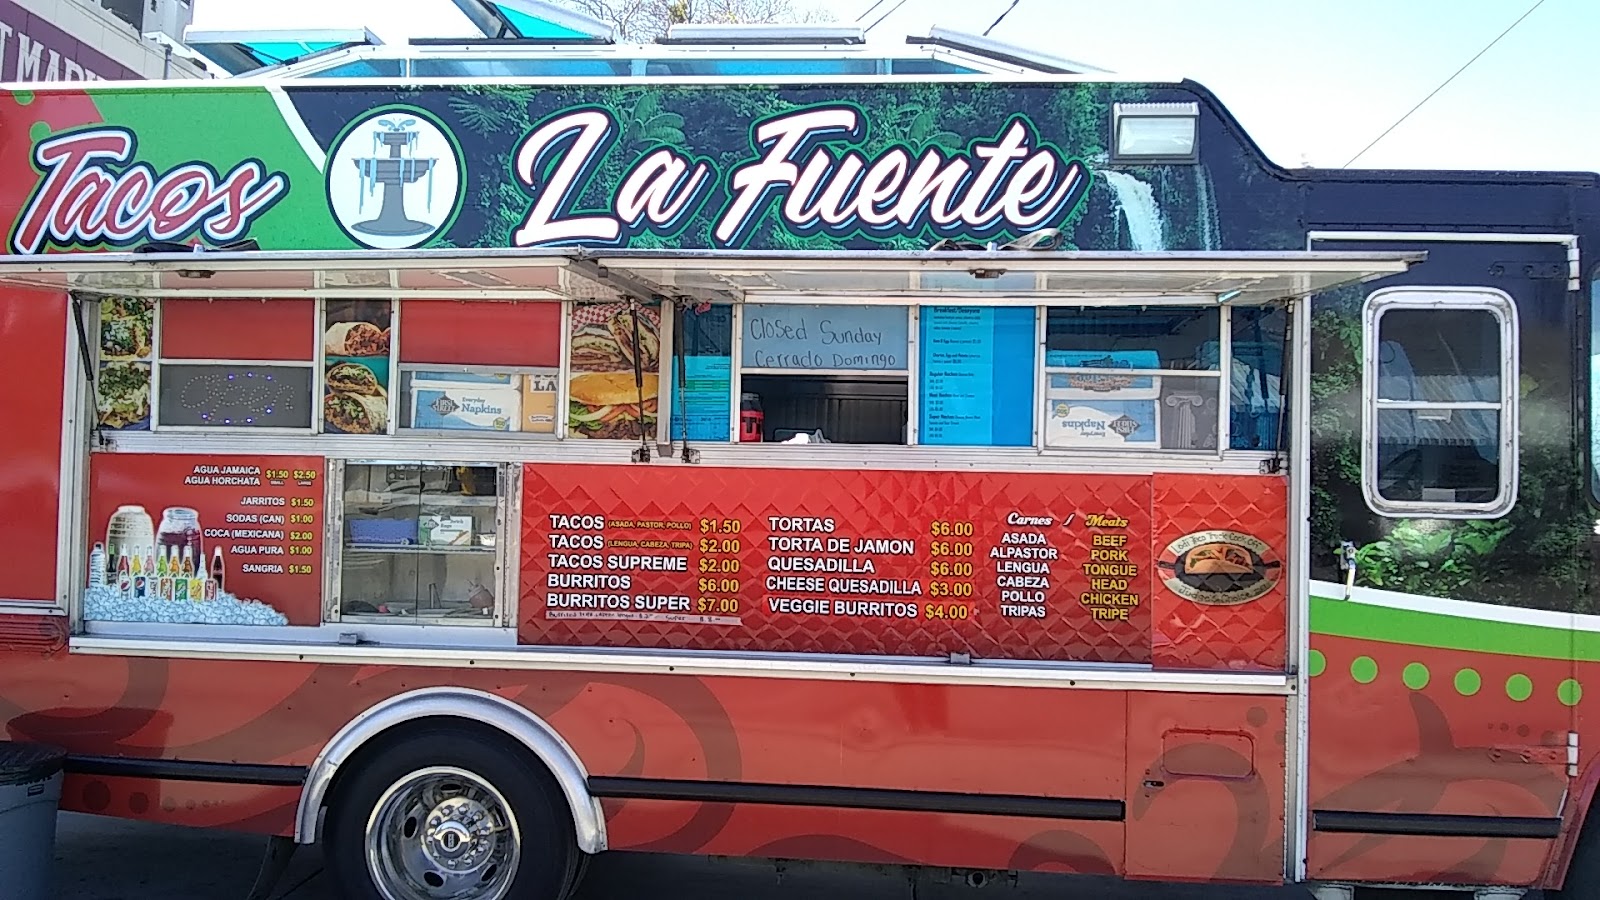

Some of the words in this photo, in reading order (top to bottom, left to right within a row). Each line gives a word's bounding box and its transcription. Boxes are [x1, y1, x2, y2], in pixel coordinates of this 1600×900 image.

[515, 110, 709, 247] La
[714, 110, 1081, 243] Fuente
[14, 130, 284, 253] Tacos
[819, 319, 882, 346] Sunday
[755, 349, 823, 368] Cerrado
[832, 353, 896, 370] Domingo
[180, 373, 295, 424] Open
[462, 396, 486, 404] Everyday
[461, 403, 502, 416] Napkins
[1062, 419, 1106, 430] Napkins
[193, 466, 221, 474] AGUA
[221, 466, 260, 475] JAMAICA
[266, 469, 289, 480] $1.50
[293, 470, 316, 480] $2.50
[184, 476, 212, 485] AGUA
[212, 476, 260, 486] HORCHATA
[240, 497, 286, 506] JARRITOS
[290, 497, 314, 507] $1.50
[226, 514, 258, 523] SODAS
[259, 514, 286, 525] (CAN)
[290, 514, 313, 524] $1.00
[549, 514, 605, 530] TACOS
[608, 520, 636, 529] (ASADA,
[666, 521, 692, 530] POLLO)
[700, 518, 740, 534] $1.50
[768, 516, 834, 532] TORTAS
[931, 521, 974, 536] $6.00
[1007, 512, 1053, 526] Carnes
[1085, 514, 1128, 528] Meats
[204, 528, 230, 538] COCA
[231, 529, 284, 540] (MEXICANA)
[290, 530, 312, 540] $2.00
[1001, 532, 1047, 545] ASADA
[1093, 534, 1127, 546] BEEF
[230, 546, 257, 554] AGUA
[258, 546, 284, 555] PURA
[289, 545, 312, 555] $1.00
[548, 534, 604, 550] TACOS
[671, 541, 694, 550] TRIPA)
[699, 538, 740, 554] $2.00
[768, 536, 824, 552] TORTA
[827, 538, 850, 553] DE
[854, 539, 914, 554] JAMON
[931, 542, 973, 556] $6.00
[990, 547, 1058, 560] ALPASTOR
[1091, 549, 1128, 562] PORK
[242, 564, 284, 574] SANGRIA
[288, 564, 312, 574] $1.50
[548, 554, 603, 569] TACOS
[607, 556, 688, 571] SUPREME
[698, 558, 740, 573] $2.00
[767, 556, 875, 574] QUESADILLA
[930, 562, 972, 576] $6.00
[996, 561, 1050, 574] LENGUA
[1083, 564, 1138, 576] TONGUE
[547, 574, 631, 589] BURRITOS
[698, 578, 740, 592] $6.00
[766, 576, 825, 592] CHEESE
[828, 579, 922, 595] QUESADILLA
[930, 582, 972, 597] $3.00
[996, 576, 1050, 588] CABEZA
[1091, 579, 1128, 591] HEAD
[1001, 590, 1045, 603] POLLO
[1080, 593, 1139, 606] CHICKEN
[546, 594, 630, 609] BURRITOS
[634, 596, 690, 610] SUPER
[698, 598, 738, 613] $7.00
[768, 598, 830, 614] VEGGIE
[834, 600, 918, 618] BURRITOS
[925, 604, 968, 620] $4.00
[1000, 604, 1046, 618] TRIPAS
[1091, 607, 1128, 620] TRIPE
